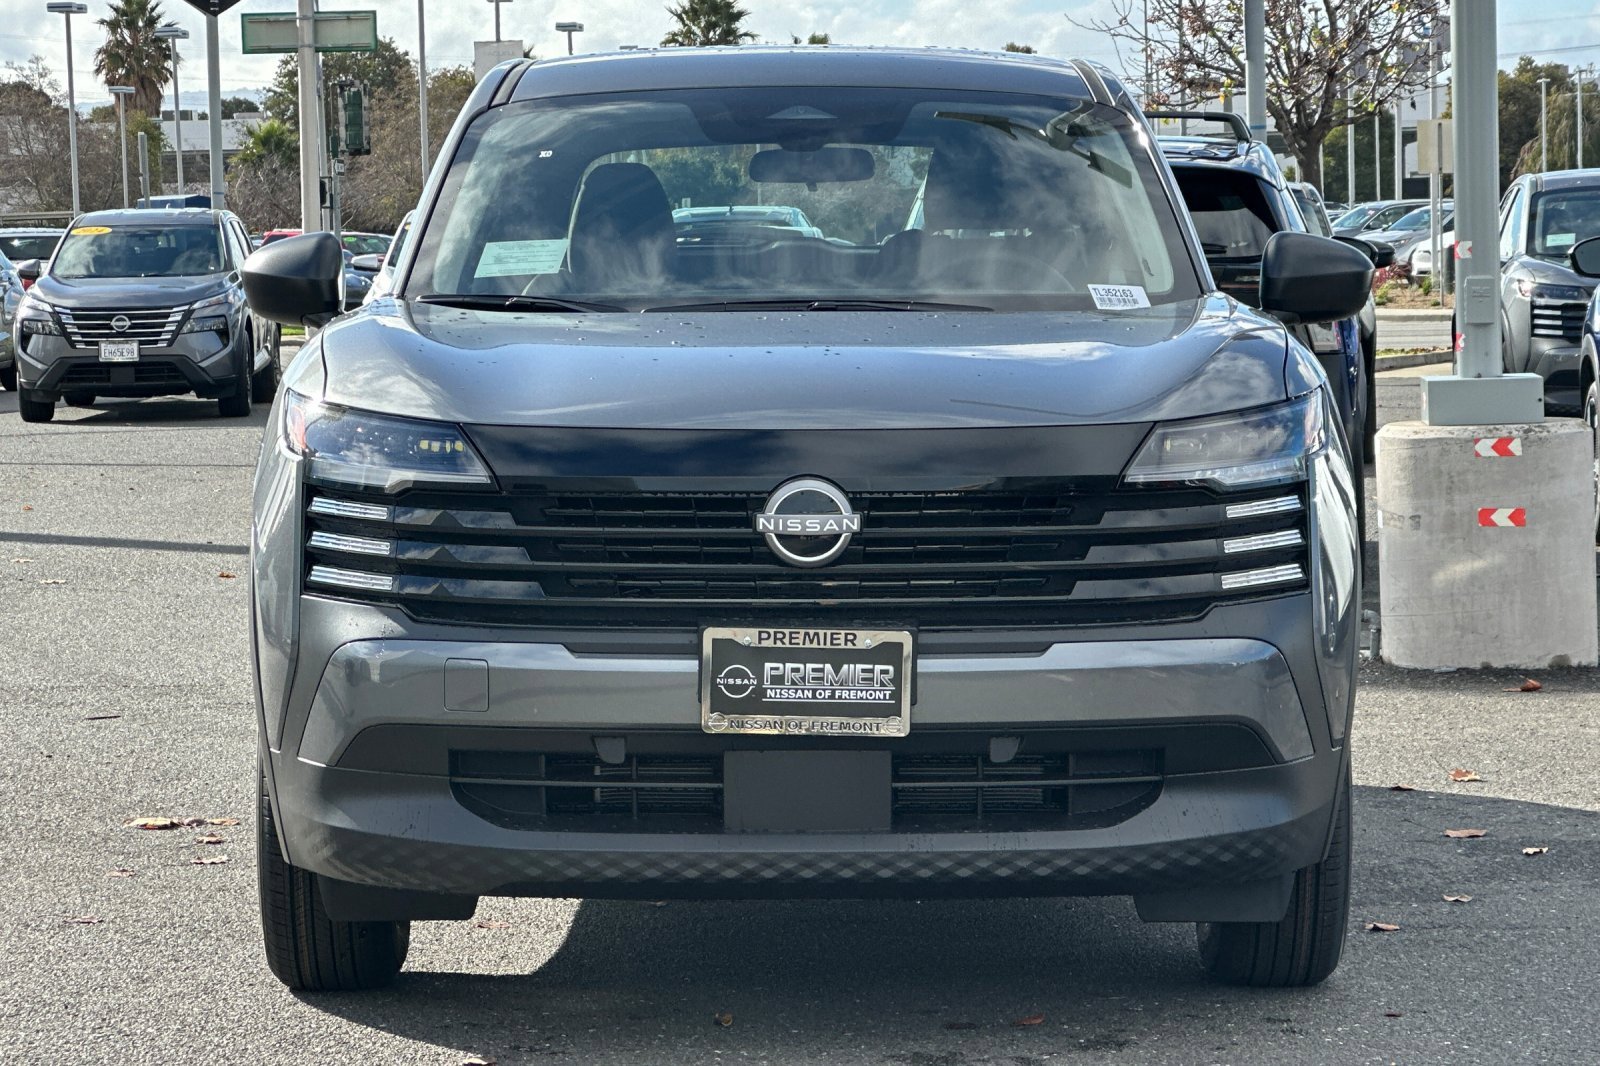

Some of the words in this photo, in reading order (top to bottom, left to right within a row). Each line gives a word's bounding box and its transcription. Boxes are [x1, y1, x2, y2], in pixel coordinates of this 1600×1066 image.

[1091, 287, 1134, 298] TL352163
[103, 348, 135, 358] EH65E98
[759, 517, 858, 531] NISSAN
[757, 630, 858, 646] PREMIER
[716, 677, 758, 686] NISSAN
[763, 662, 895, 688] PREMIER
[766, 688, 813, 699] NISSAN
[815, 689, 832, 700] OF
[835, 690, 892, 700] FREMONT
[729, 718, 784, 730] NISSAN
[787, 720, 808, 732] OF
[811, 721, 883, 732] FREMONT
